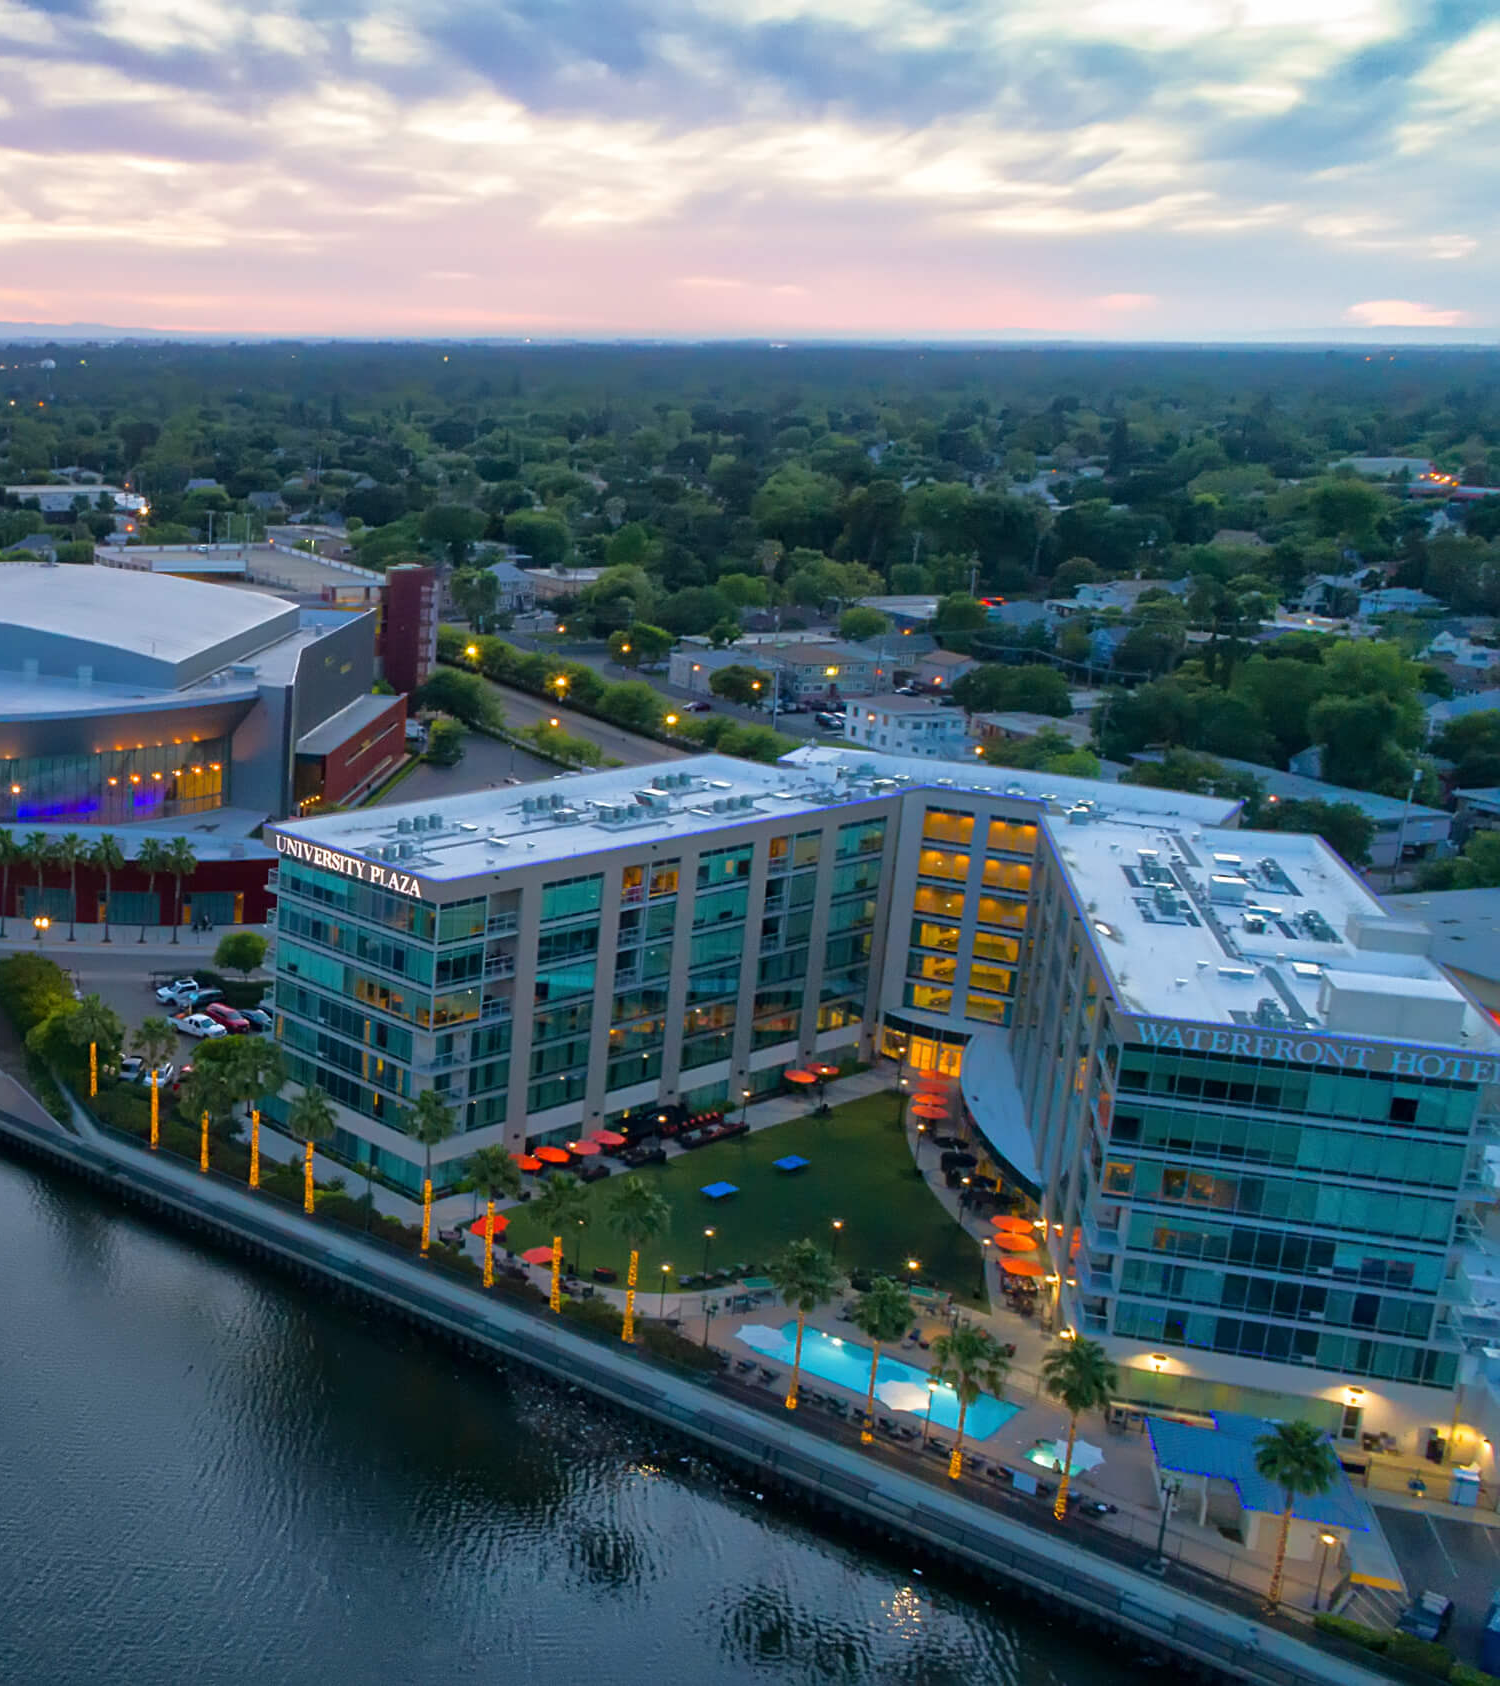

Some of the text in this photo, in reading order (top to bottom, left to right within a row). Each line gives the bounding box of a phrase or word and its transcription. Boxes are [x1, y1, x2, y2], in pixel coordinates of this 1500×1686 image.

[276, 834, 421, 898] UNIVERSITY PLAZA
[1137, 1022, 1375, 1070] WATERFRONT
